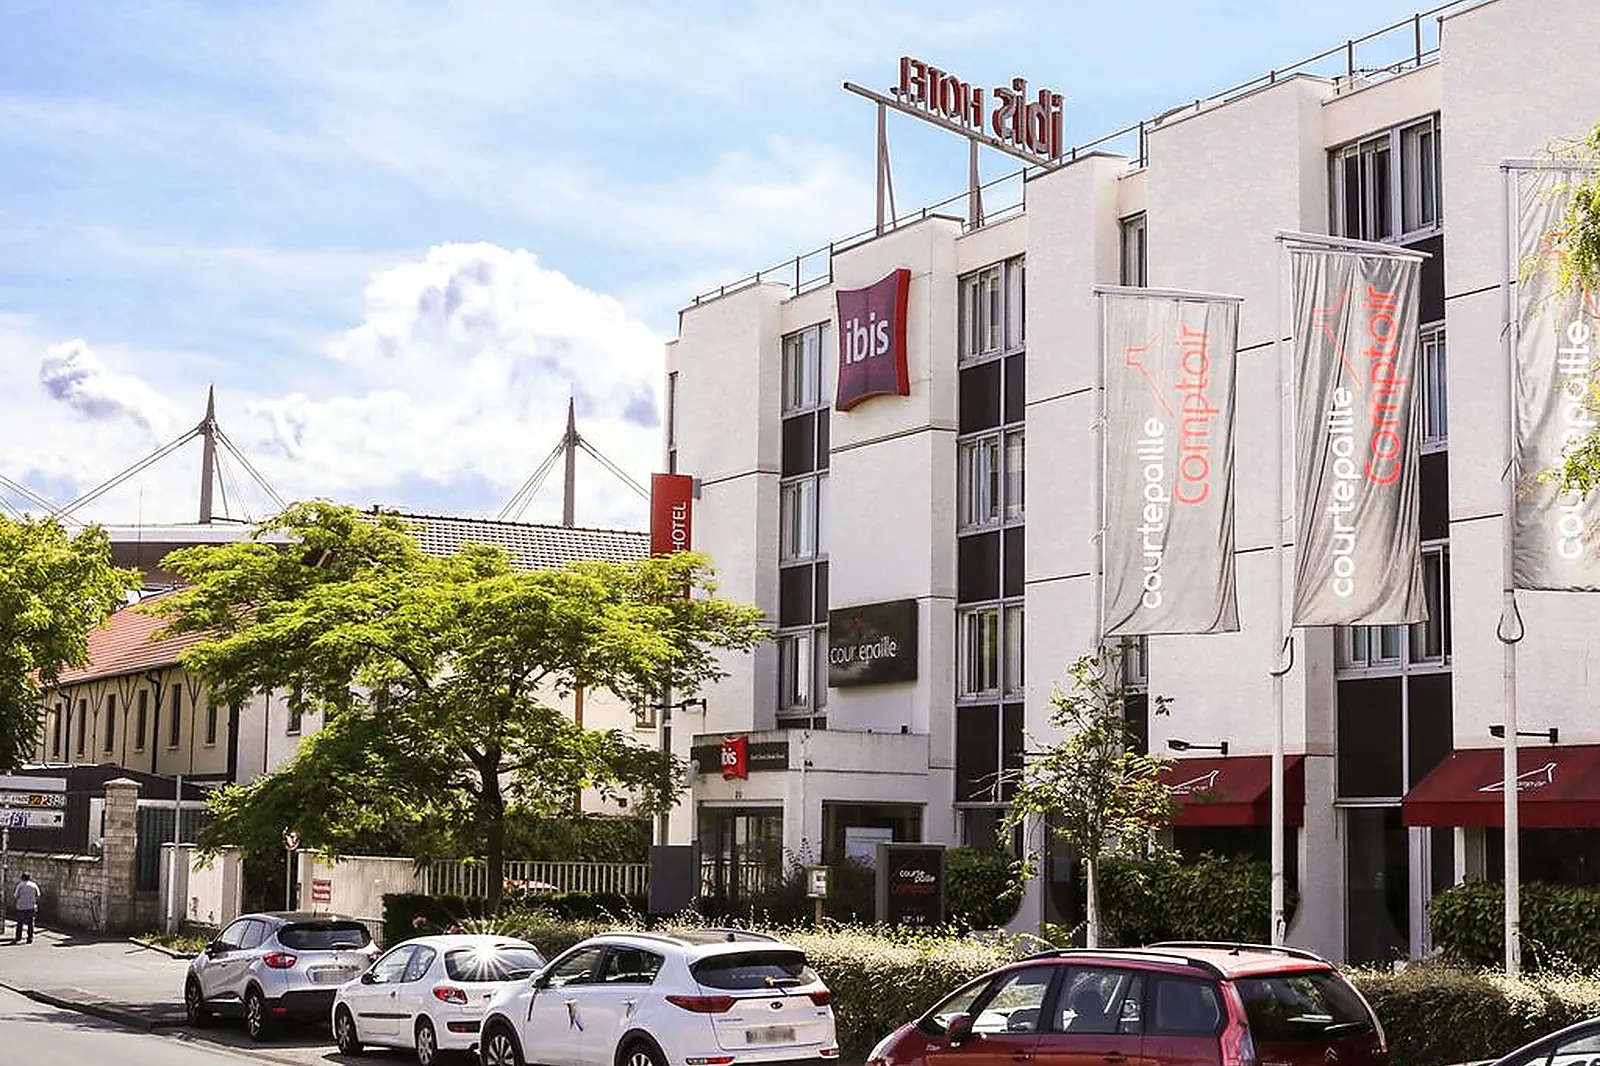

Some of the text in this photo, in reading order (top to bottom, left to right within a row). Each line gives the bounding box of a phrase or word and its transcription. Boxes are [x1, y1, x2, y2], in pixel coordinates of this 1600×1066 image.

[846, 312, 889, 365] ibis
[1174, 323, 1220, 505] Comptoir
[1362, 283, 1409, 484] Comptoir
[671, 501, 687, 554] HOTEL
[1137, 417, 1171, 609] courtepaille
[1327, 386, 1362, 597] courtepaille
